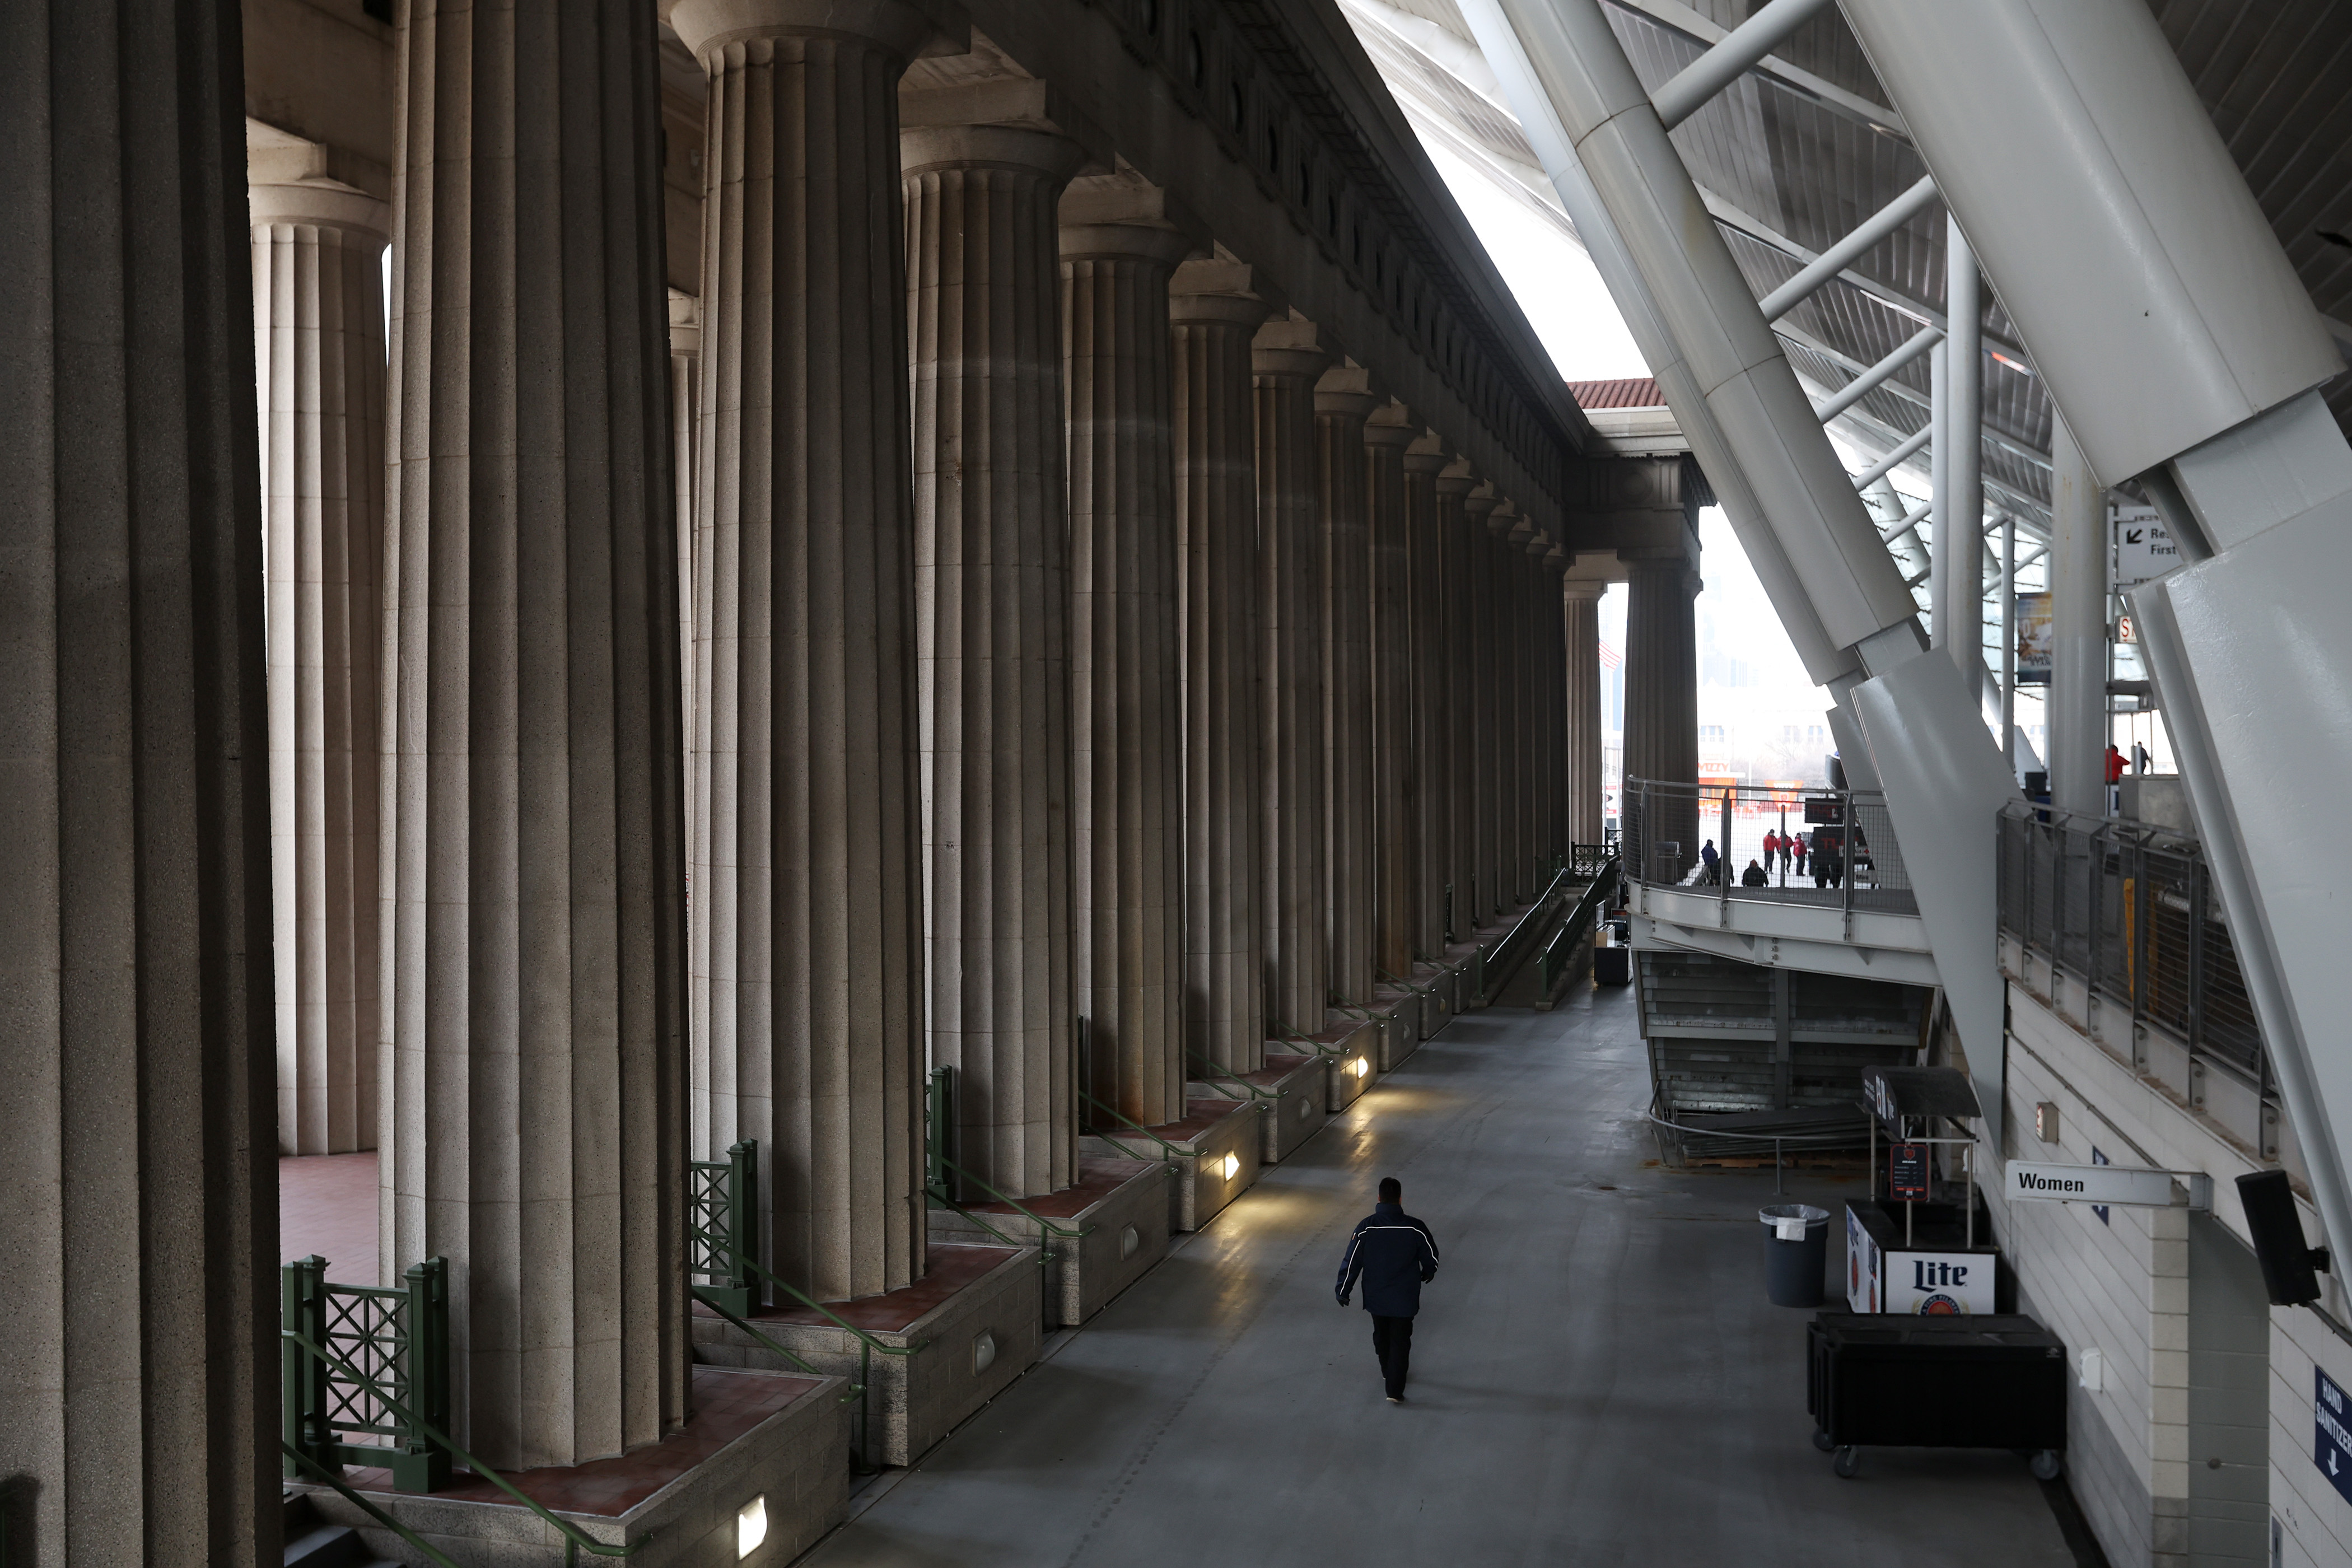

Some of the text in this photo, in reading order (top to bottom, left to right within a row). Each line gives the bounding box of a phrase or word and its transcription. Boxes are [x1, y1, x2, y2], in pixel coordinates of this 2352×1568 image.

[2019, 1173, 2084, 1192] Women
[1912, 1261, 1968, 1293] Lite
[2322, 1378, 2342, 1415] HAND
[2316, 1401, 2352, 1458] SANITIZER
